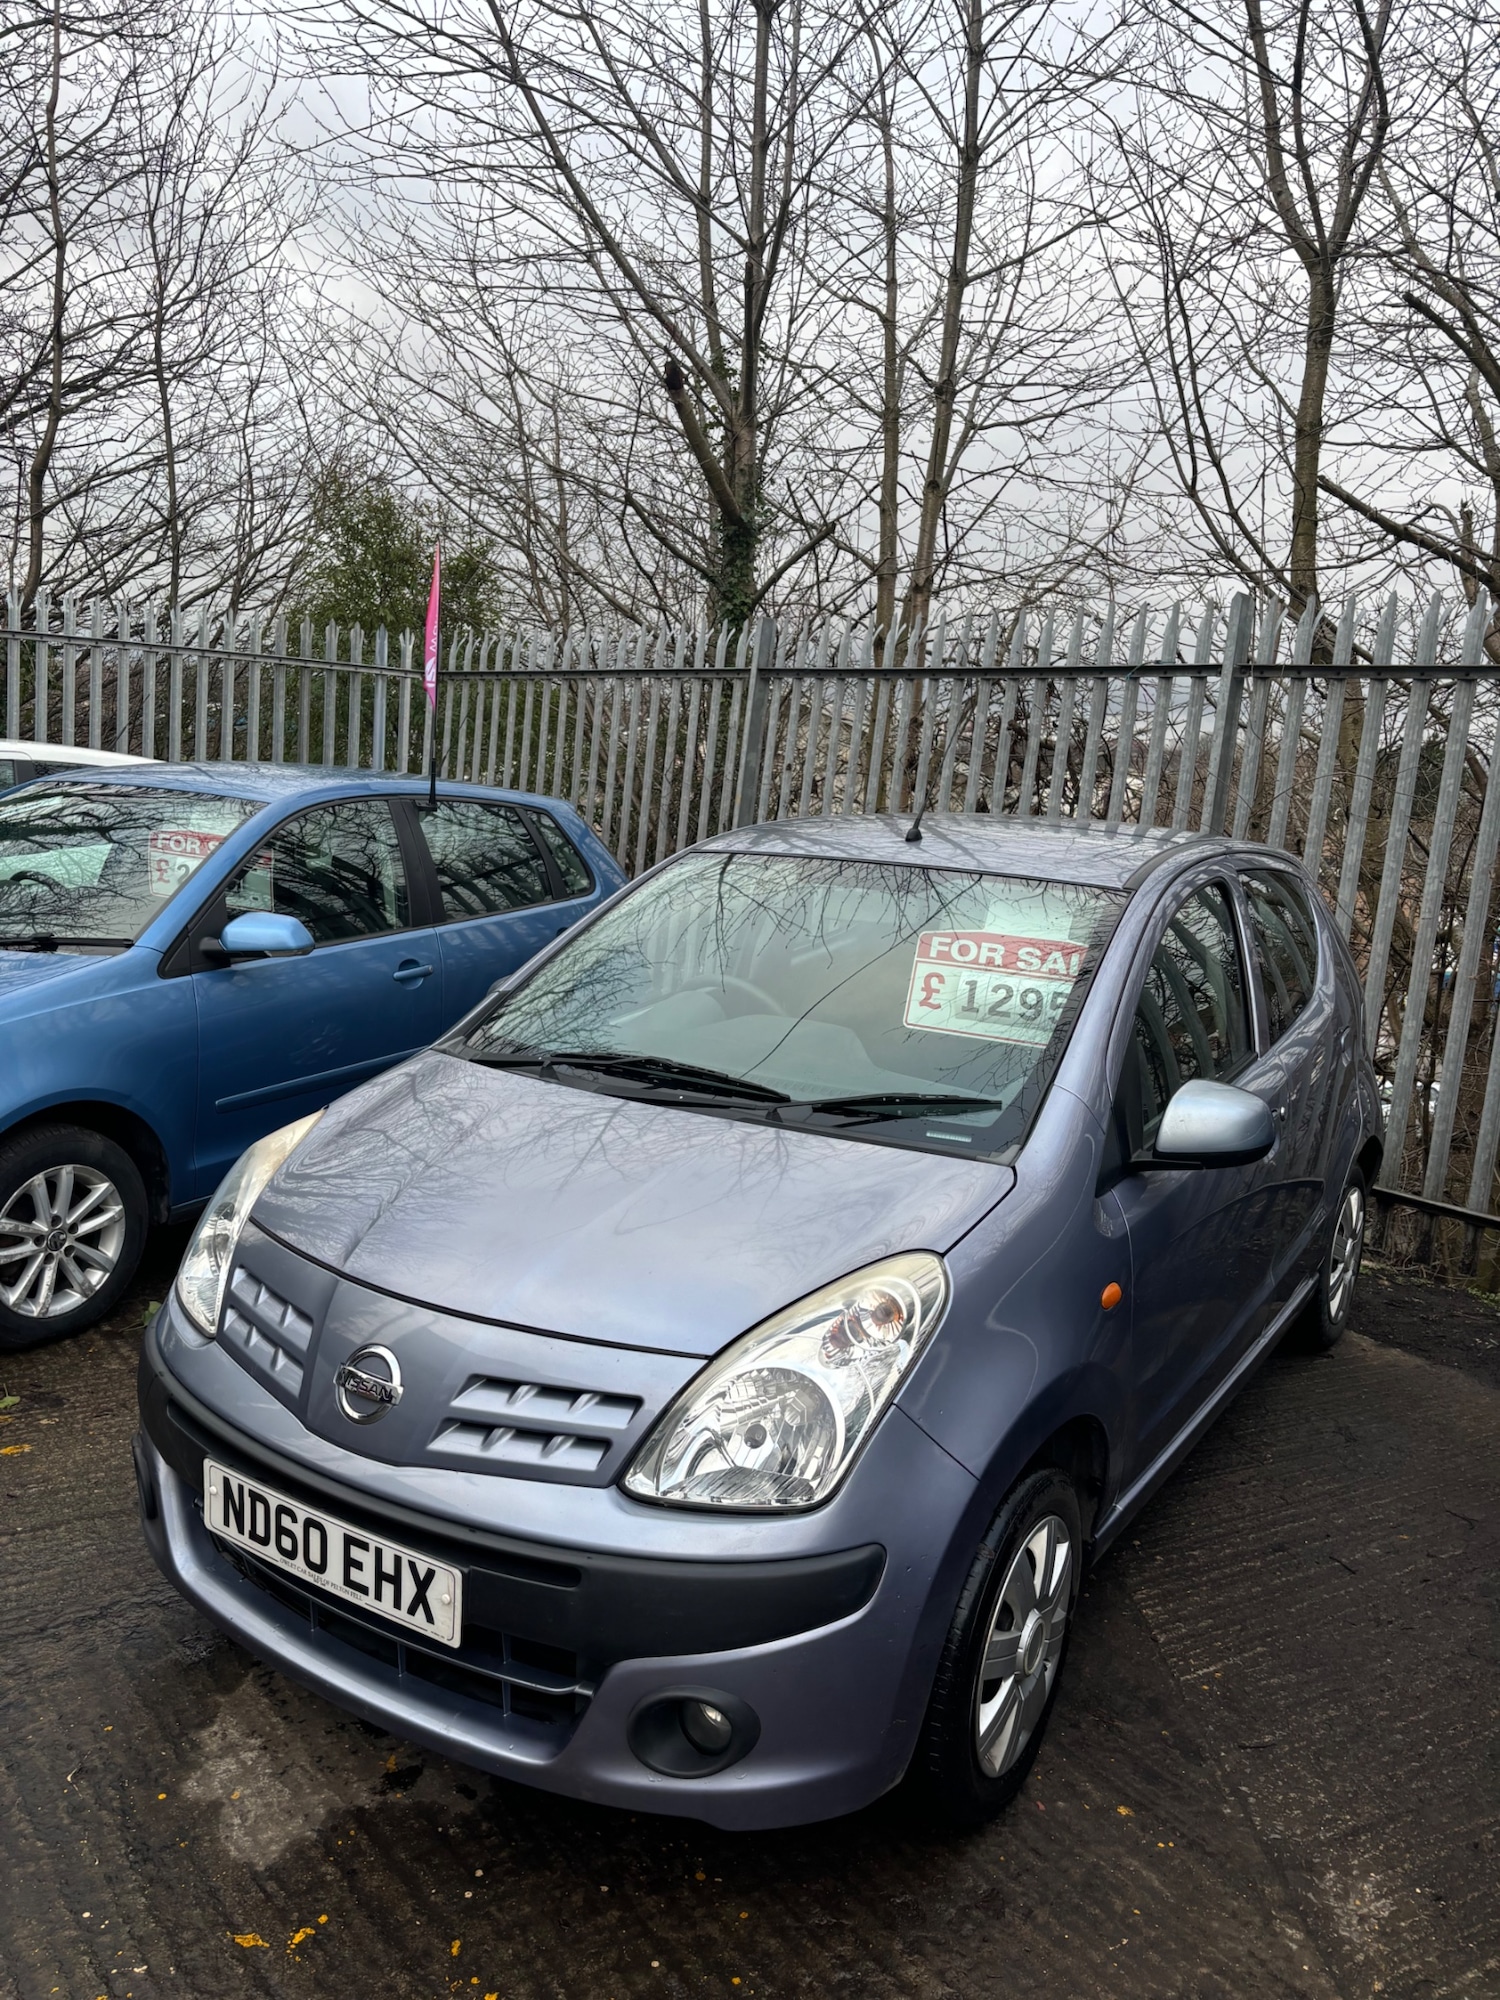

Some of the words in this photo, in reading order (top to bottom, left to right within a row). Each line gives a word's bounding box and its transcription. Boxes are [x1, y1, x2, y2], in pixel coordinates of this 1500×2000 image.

[157, 833, 201, 854] FOR
[155, 858, 170, 884] £
[929, 936, 1006, 966] FOR
[918, 971, 946, 1010] £
[222, 1475, 328, 1575] ND60
[343, 1532, 436, 1626] EHX
